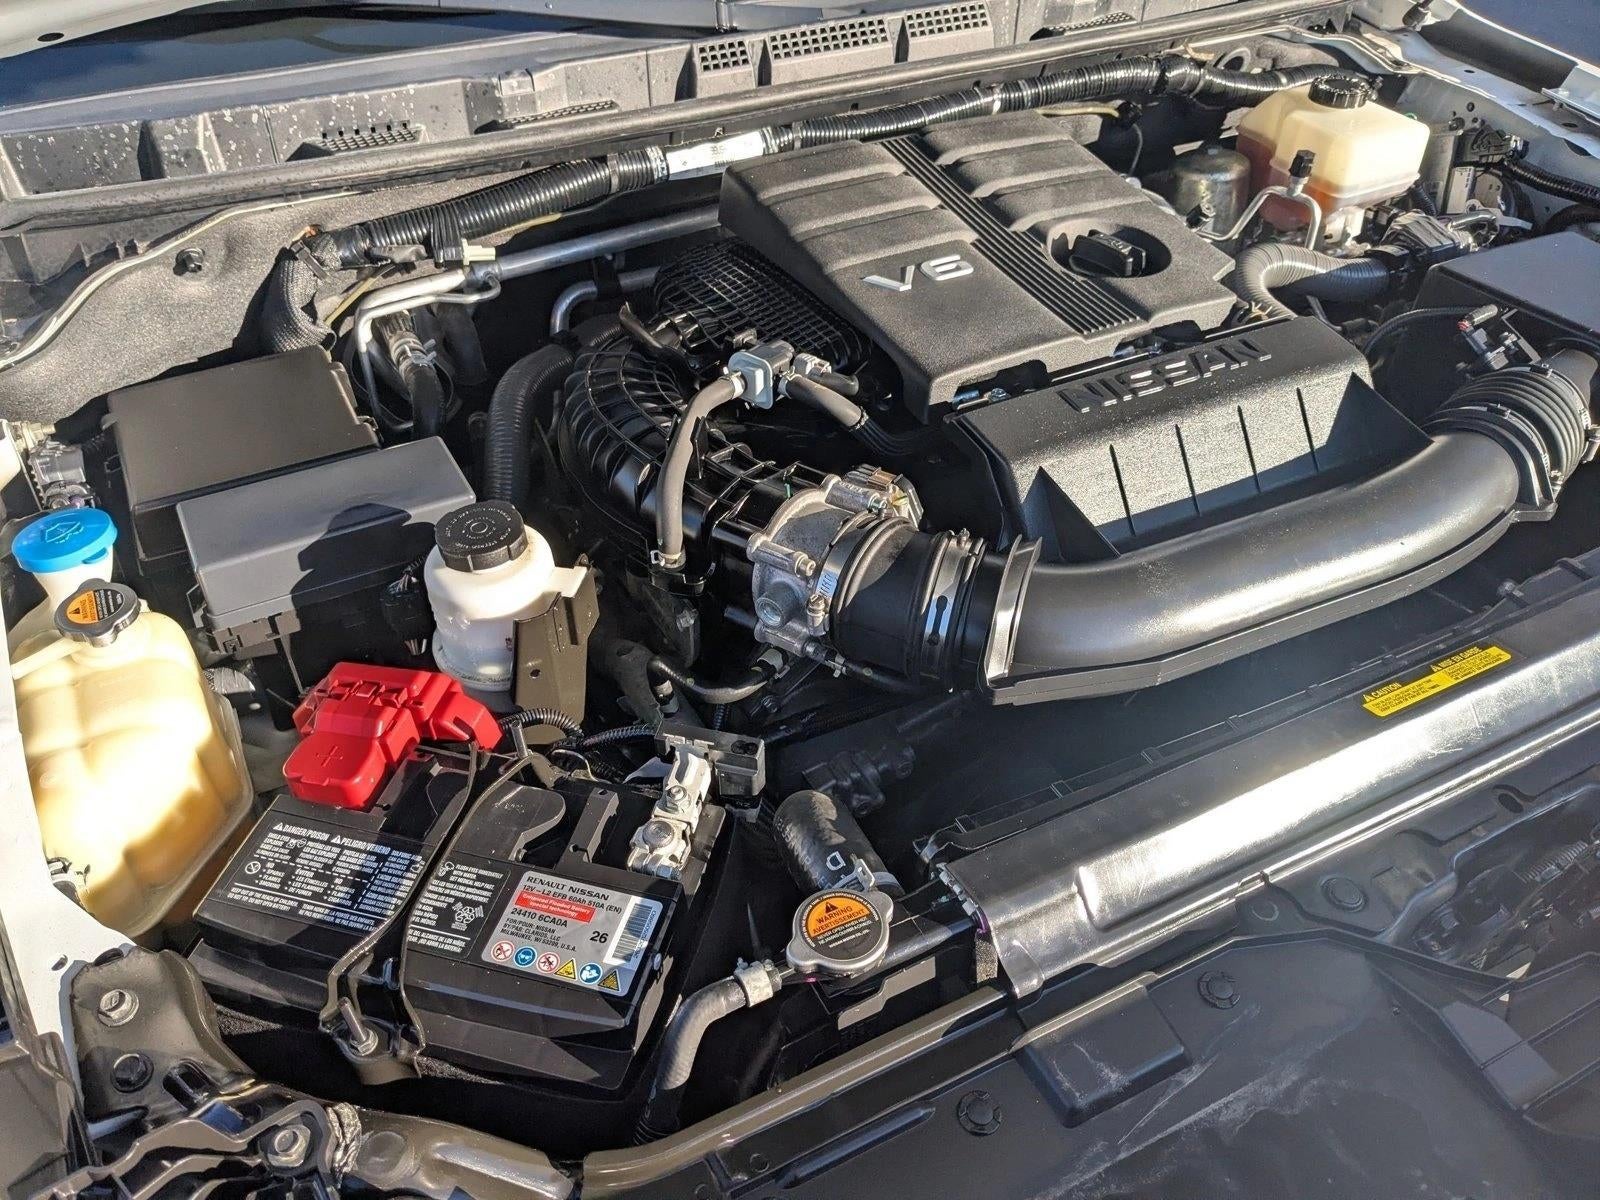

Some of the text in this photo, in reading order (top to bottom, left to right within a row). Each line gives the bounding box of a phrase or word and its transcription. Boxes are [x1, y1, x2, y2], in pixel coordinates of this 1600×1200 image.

[861, 254, 974, 292] V6
[1056, 338, 1272, 413] NISSAN
[1371, 682, 1402, 699] CAUTION
[283, 824, 330, 841] DANGER/POISON
[341, 838, 390, 855] PELIGRO/VENENO
[527, 876, 609, 901] RENAULT NISSAN
[522, 893, 591, 915] Enhanced Flooded Battery
[552, 892, 567, 900] EFB
[568, 896, 587, 905] 60Ah
[587, 901, 605, 910] 510A
[605, 905, 622, 914] (EN)
[511, 908, 537, 919] 24410
[812, 909, 865, 934] AVERTISSEMENT
[816, 906, 853, 924] WARNING
[503, 923, 524, 932] BY/PAR:
[524, 928, 551, 938] CLARIOS,
[506, 918, 556, 933] FOR/POUR: NISSAN
[500, 928, 534, 941] MILWAUKEE,
[560, 943, 578, 952] U.S.A.
[589, 930, 609, 944] 26
